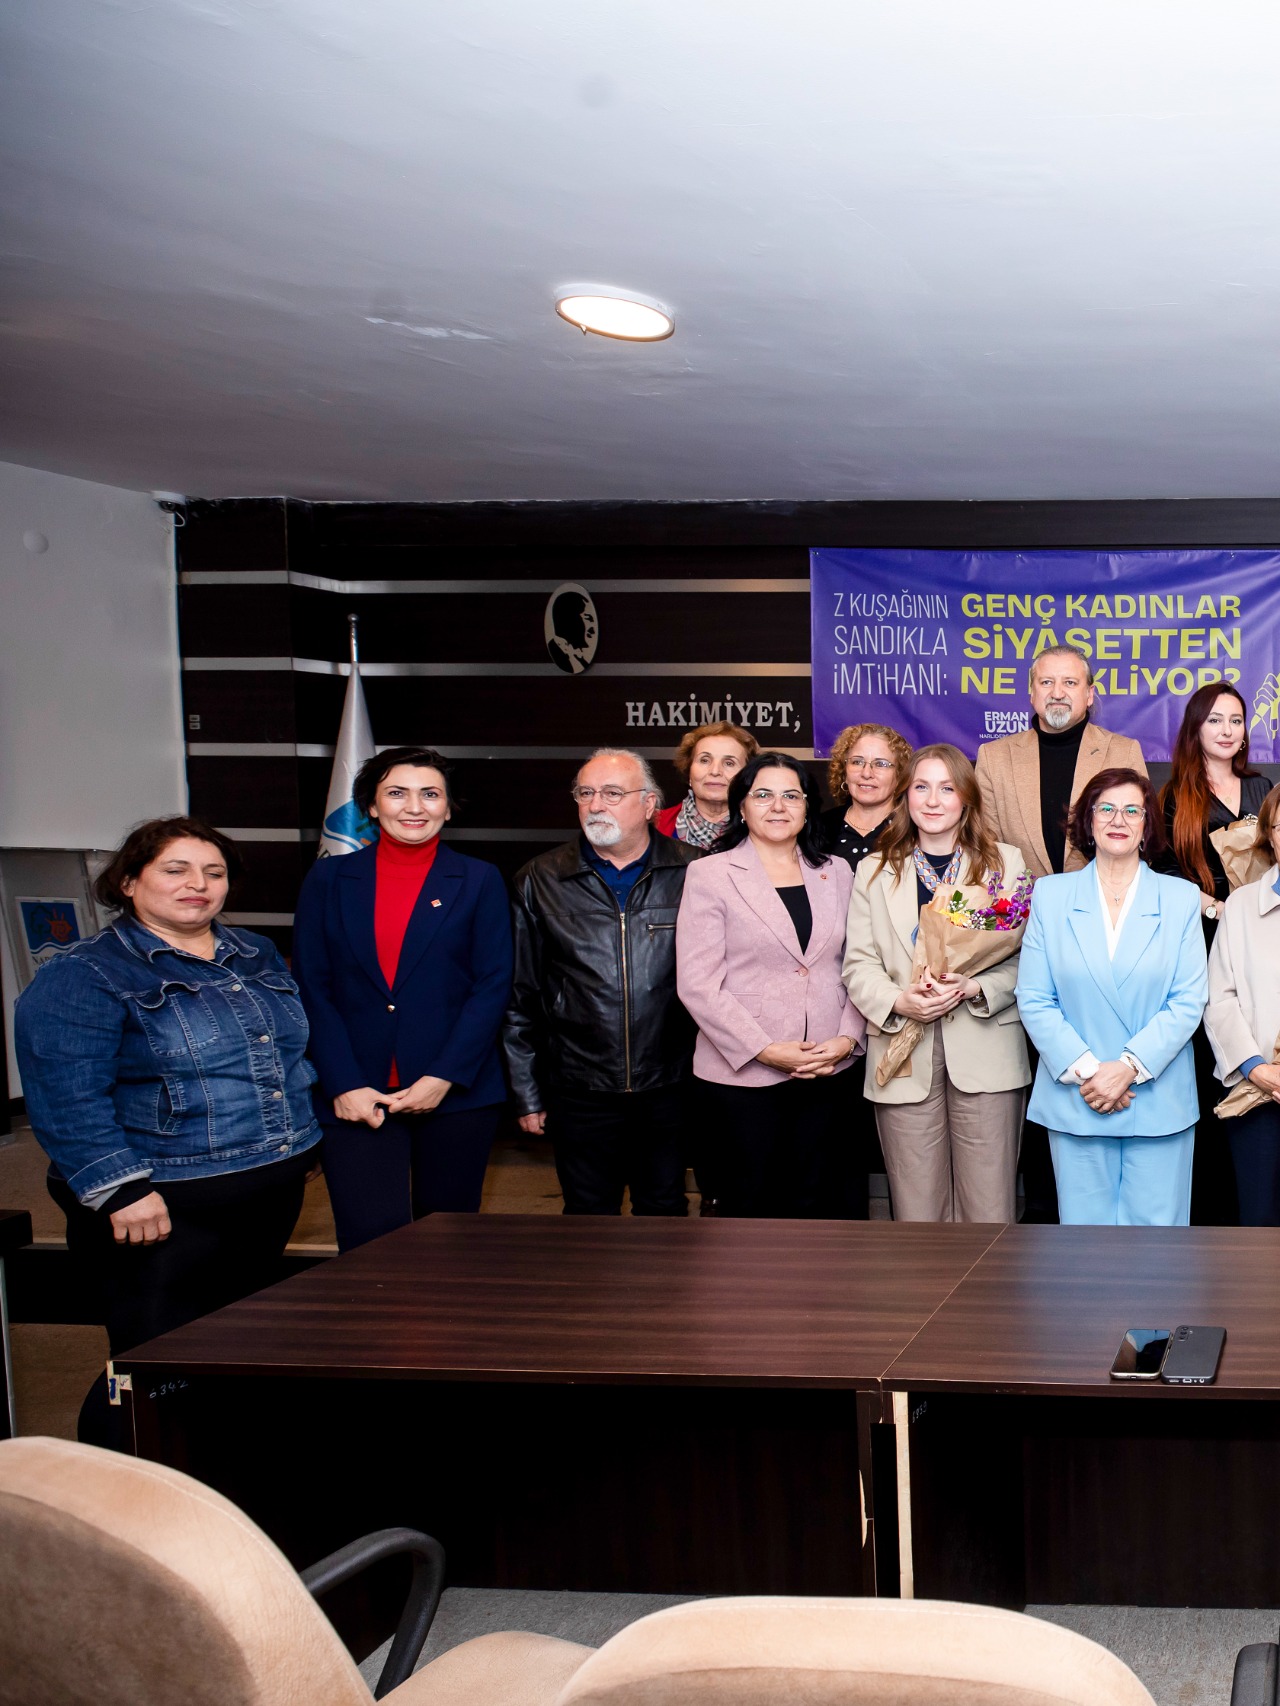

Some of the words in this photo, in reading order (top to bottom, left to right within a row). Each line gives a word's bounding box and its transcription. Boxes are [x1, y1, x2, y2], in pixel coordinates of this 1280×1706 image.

[833, 592, 845, 617] Z
[850, 588, 949, 622] KUŞAĞININ
[961, 592, 1056, 626] GENÇ
[1065, 593, 1241, 619] KADINLAR
[834, 624, 948, 656] SANDIKLA
[961, 666, 1017, 695] NE
[625, 692, 801, 733] HAKİMİYET;
[984, 711, 1029, 721] ERMAN
[985, 720, 1029, 733] UZUN
